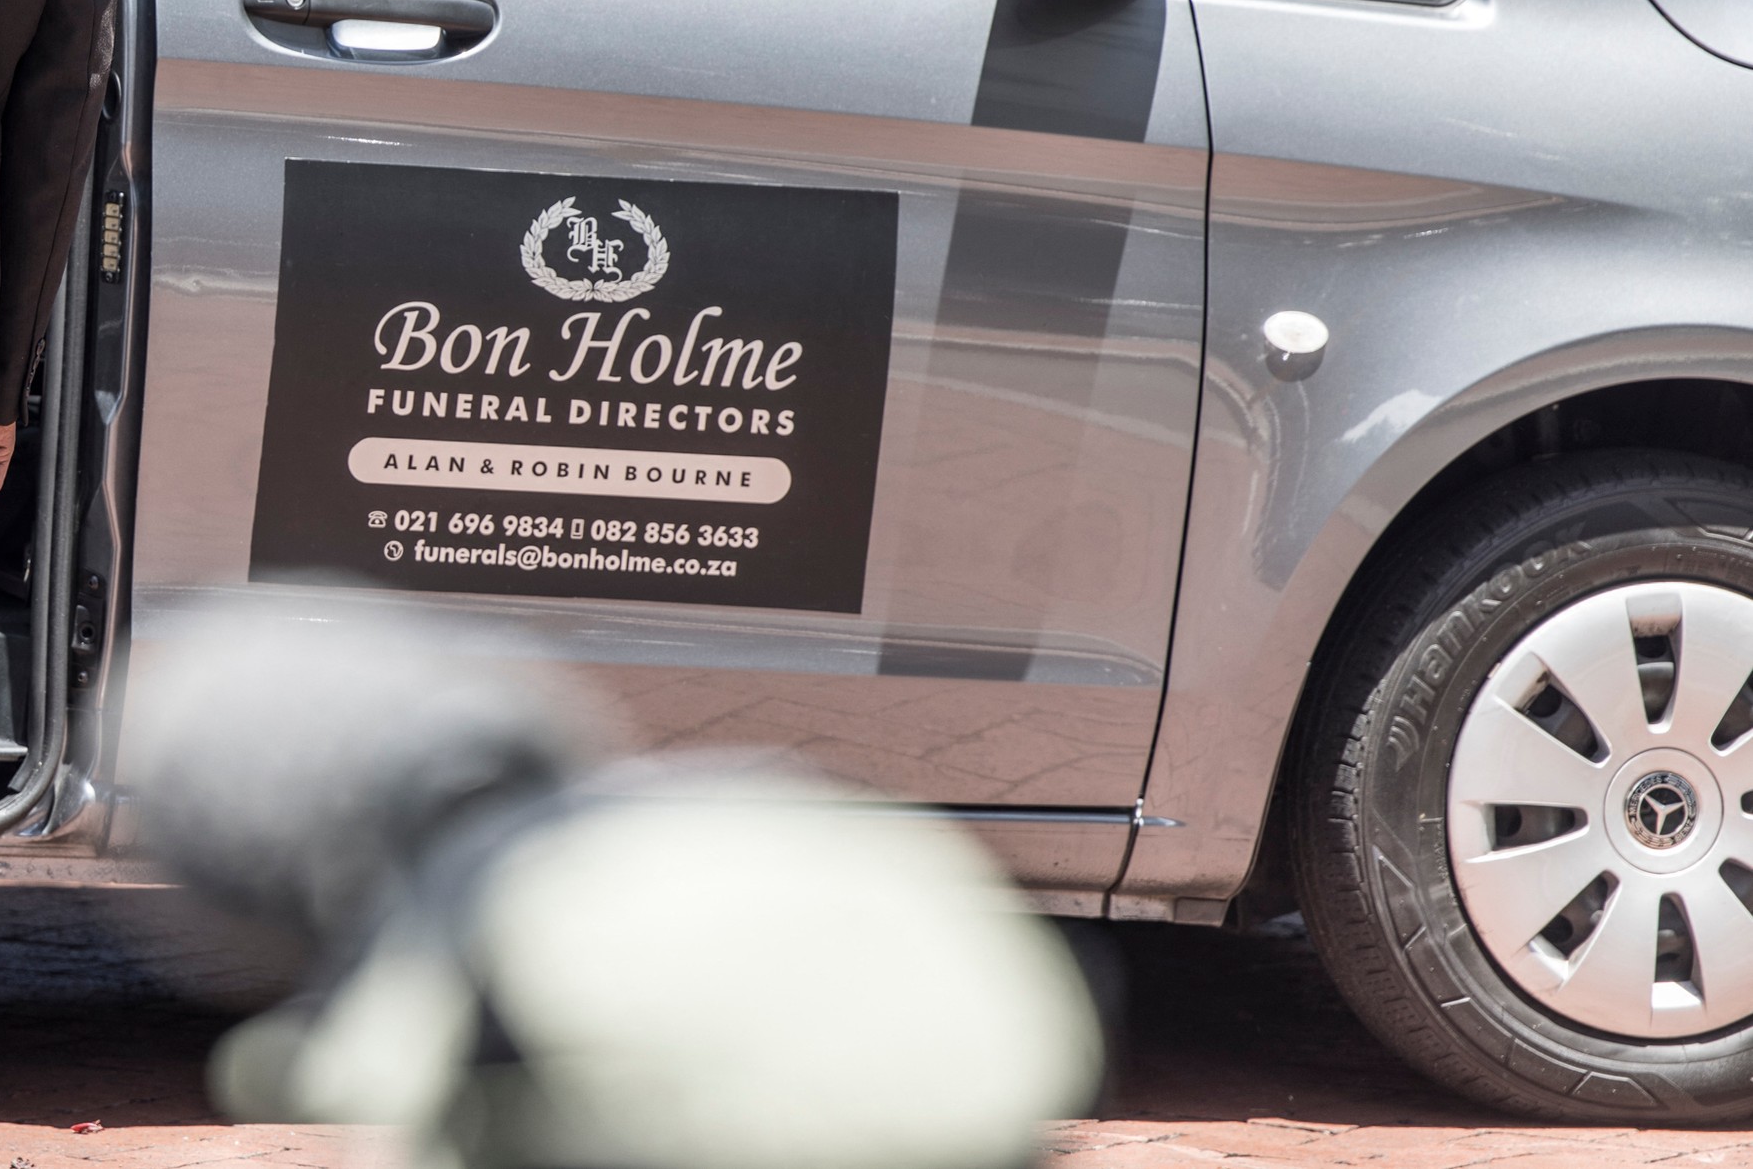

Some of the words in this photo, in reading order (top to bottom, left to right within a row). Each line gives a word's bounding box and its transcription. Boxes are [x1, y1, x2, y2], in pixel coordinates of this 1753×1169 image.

[373, 301, 531, 378] Bon
[548, 305, 804, 391] Holme
[367, 388, 552, 424] FUNERAL
[568, 398, 796, 437] DIRECTORS
[383, 453, 465, 473] ALAN
[480, 458, 495, 475] &
[510, 459, 610, 481] ROBIN
[624, 465, 752, 488] BOURNE
[394, 509, 438, 533] 021
[448, 512, 495, 536] 696
[502, 514, 565, 539] 9834
[590, 518, 638, 543] 082
[643, 521, 691, 546] 856
[697, 524, 759, 549] 3633
[414, 538, 738, 578] funerals@bonholme.co.za
